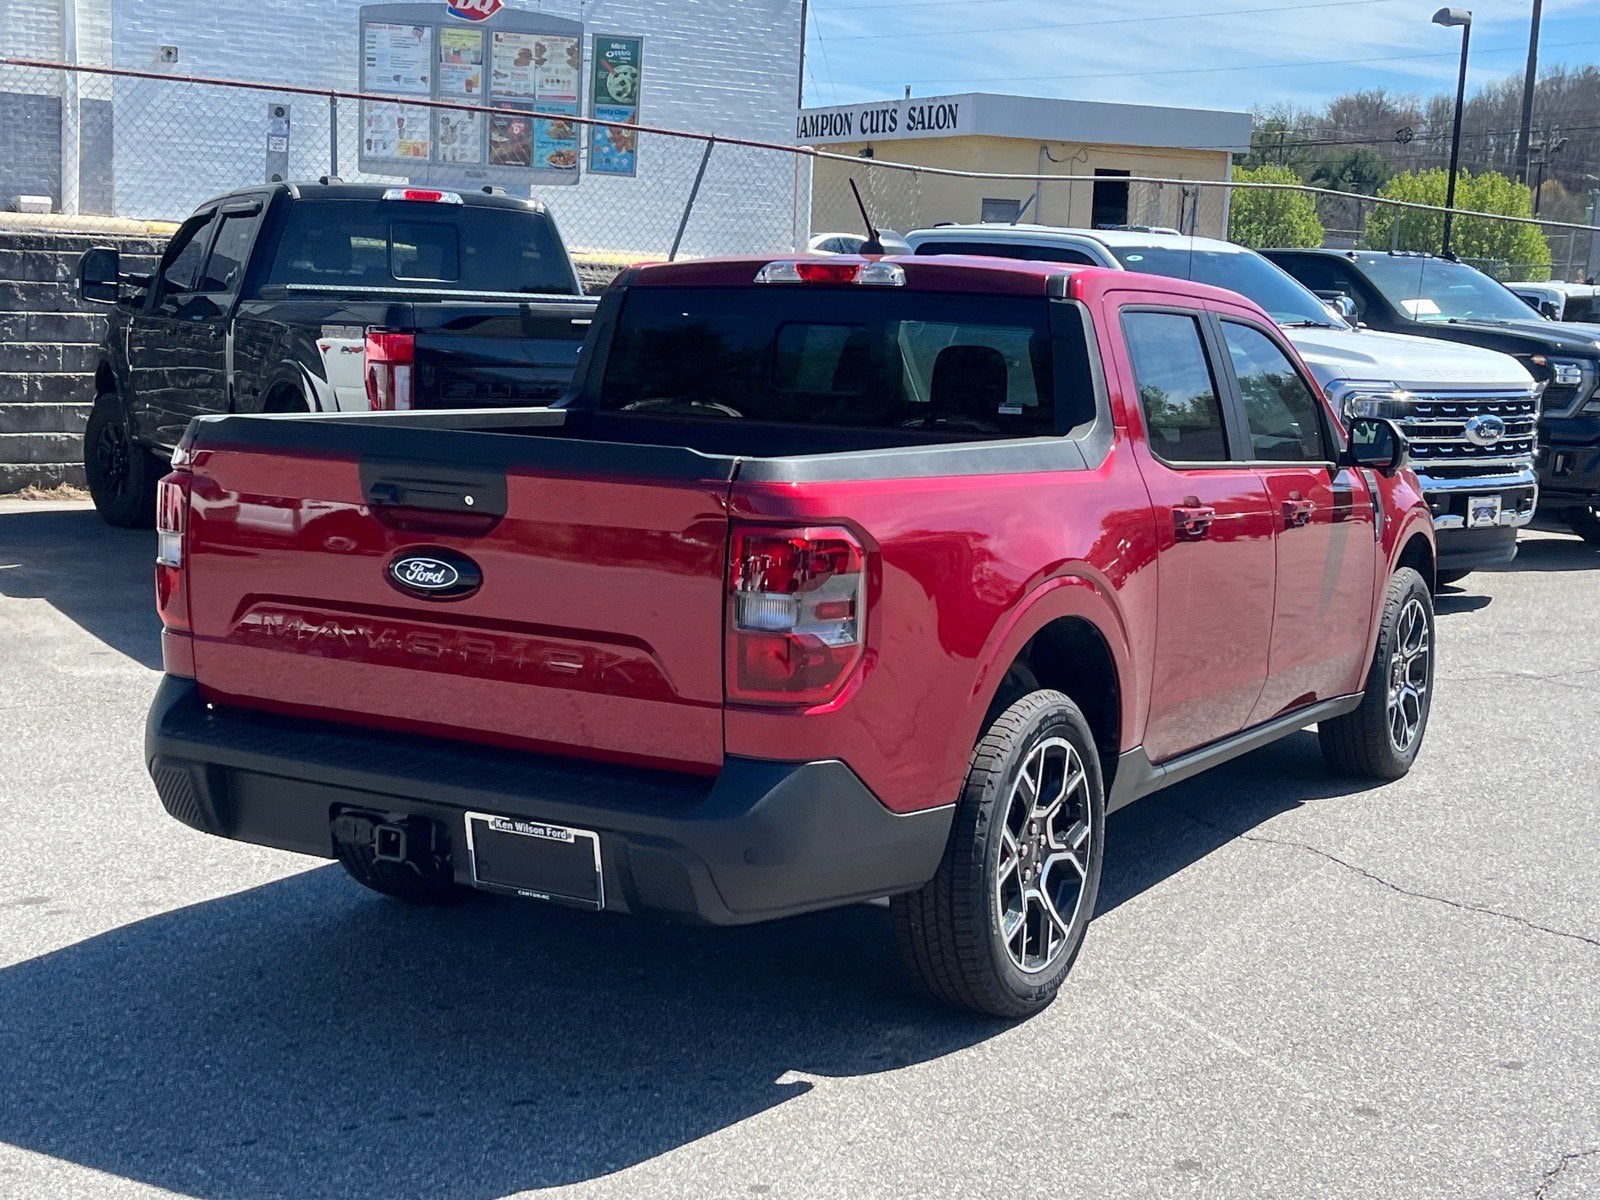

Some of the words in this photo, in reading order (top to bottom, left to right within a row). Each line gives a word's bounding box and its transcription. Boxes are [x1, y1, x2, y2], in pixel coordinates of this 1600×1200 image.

[797, 112, 853, 139] AMPION
[860, 108, 898, 134] CUTS
[906, 103, 958, 131] SALON
[403, 561, 446, 583] Ford
[260, 612, 638, 684] MAVERICK
[495, 819, 512, 830] Ken
[515, 822, 544, 834] Wilson
[546, 827, 567, 839] Ford
